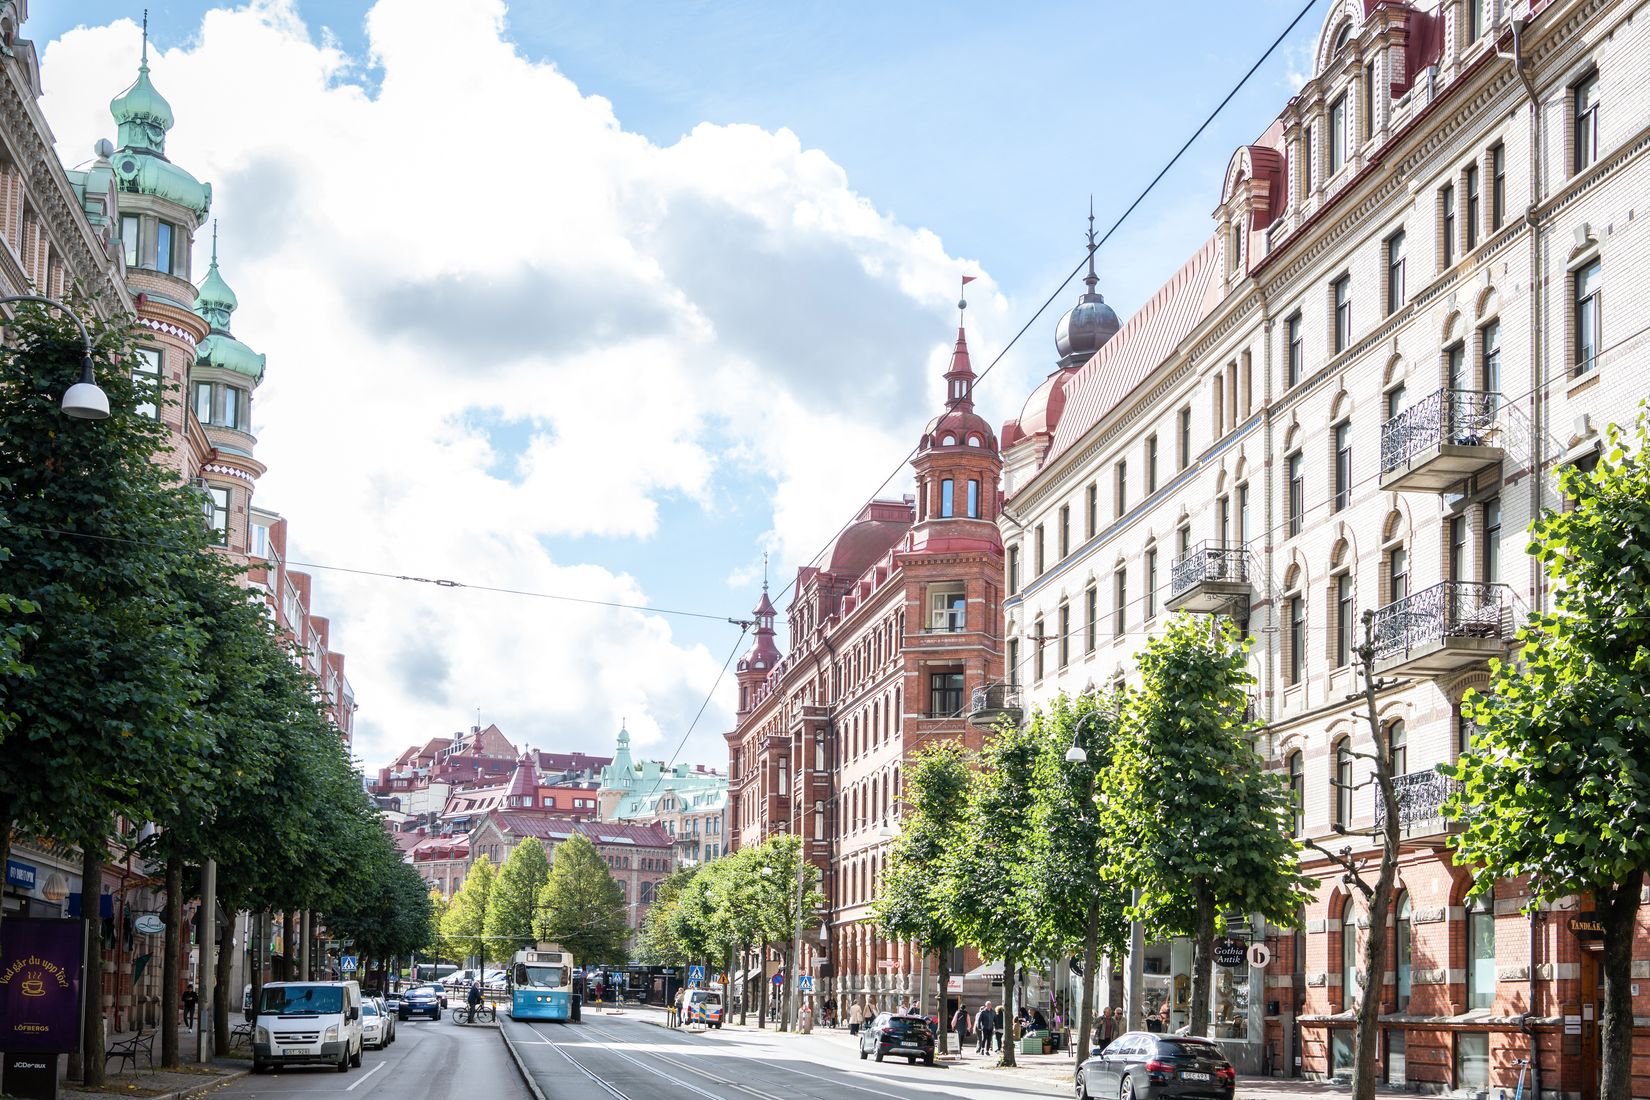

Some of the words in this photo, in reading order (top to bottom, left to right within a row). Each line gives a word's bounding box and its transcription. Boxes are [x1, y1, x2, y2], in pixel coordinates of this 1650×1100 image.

[1571, 920, 1602, 931] TANDLÄK
[1214, 947, 1243, 955] Gothia
[1217, 955, 1241, 963] Antik
[0, 968, 14, 984] Vad
[12, 959, 27, 973] går
[28, 955, 41, 965] du
[42, 960, 58, 973] upp
[55, 969, 69, 988] för?
[14, 1024, 49, 1032] LÖFBERGS
